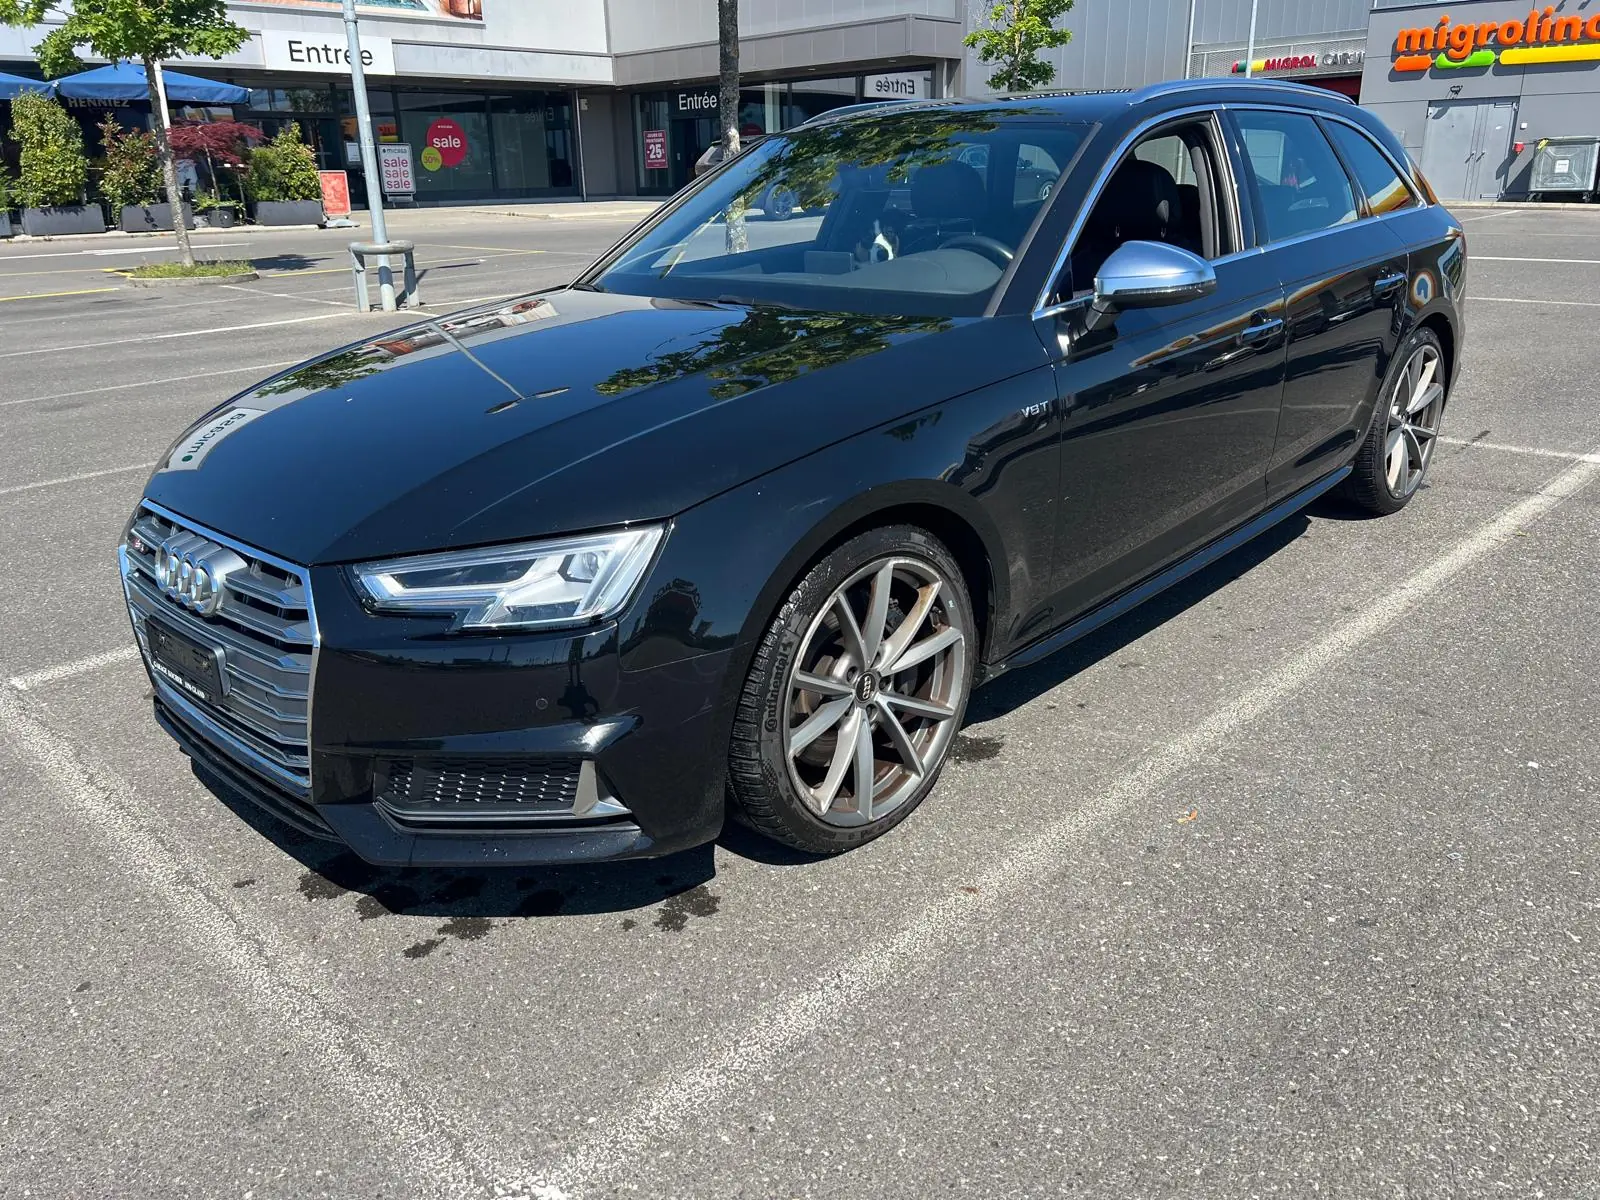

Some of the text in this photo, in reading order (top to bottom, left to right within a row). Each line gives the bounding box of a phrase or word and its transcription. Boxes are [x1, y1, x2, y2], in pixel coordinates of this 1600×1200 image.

[1397, 6, 1600, 59] migrolino
[1263, 55, 1317, 71] MIGROL
[678, 91, 717, 110] Entrée
[433, 135, 461, 148] sale
[384, 157, 408, 167] sale
[385, 168, 409, 178] sale
[386, 179, 411, 189] sale
